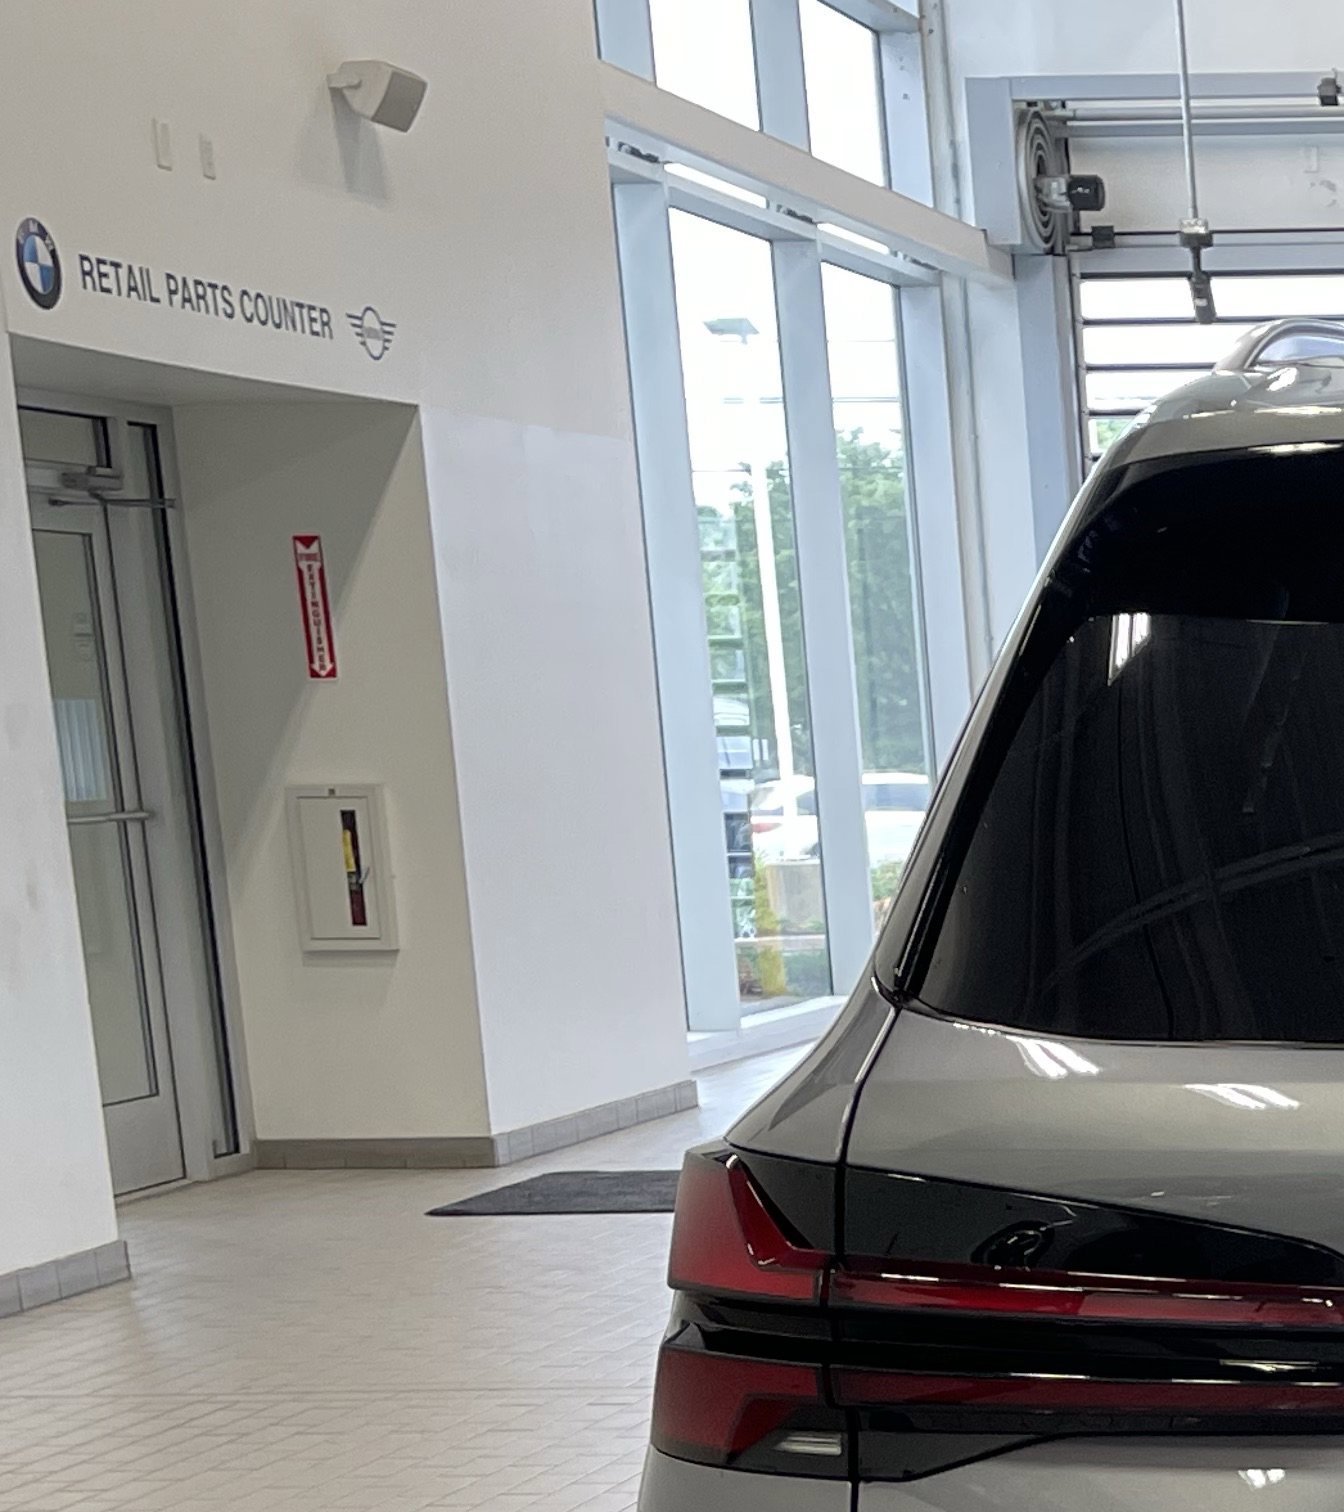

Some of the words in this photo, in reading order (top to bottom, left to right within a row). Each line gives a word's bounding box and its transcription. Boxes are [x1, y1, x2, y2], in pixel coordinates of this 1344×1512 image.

[78, 253, 161, 304] RETAIL
[165, 272, 236, 319] PARTS
[240, 288, 334, 340] COUNTER
